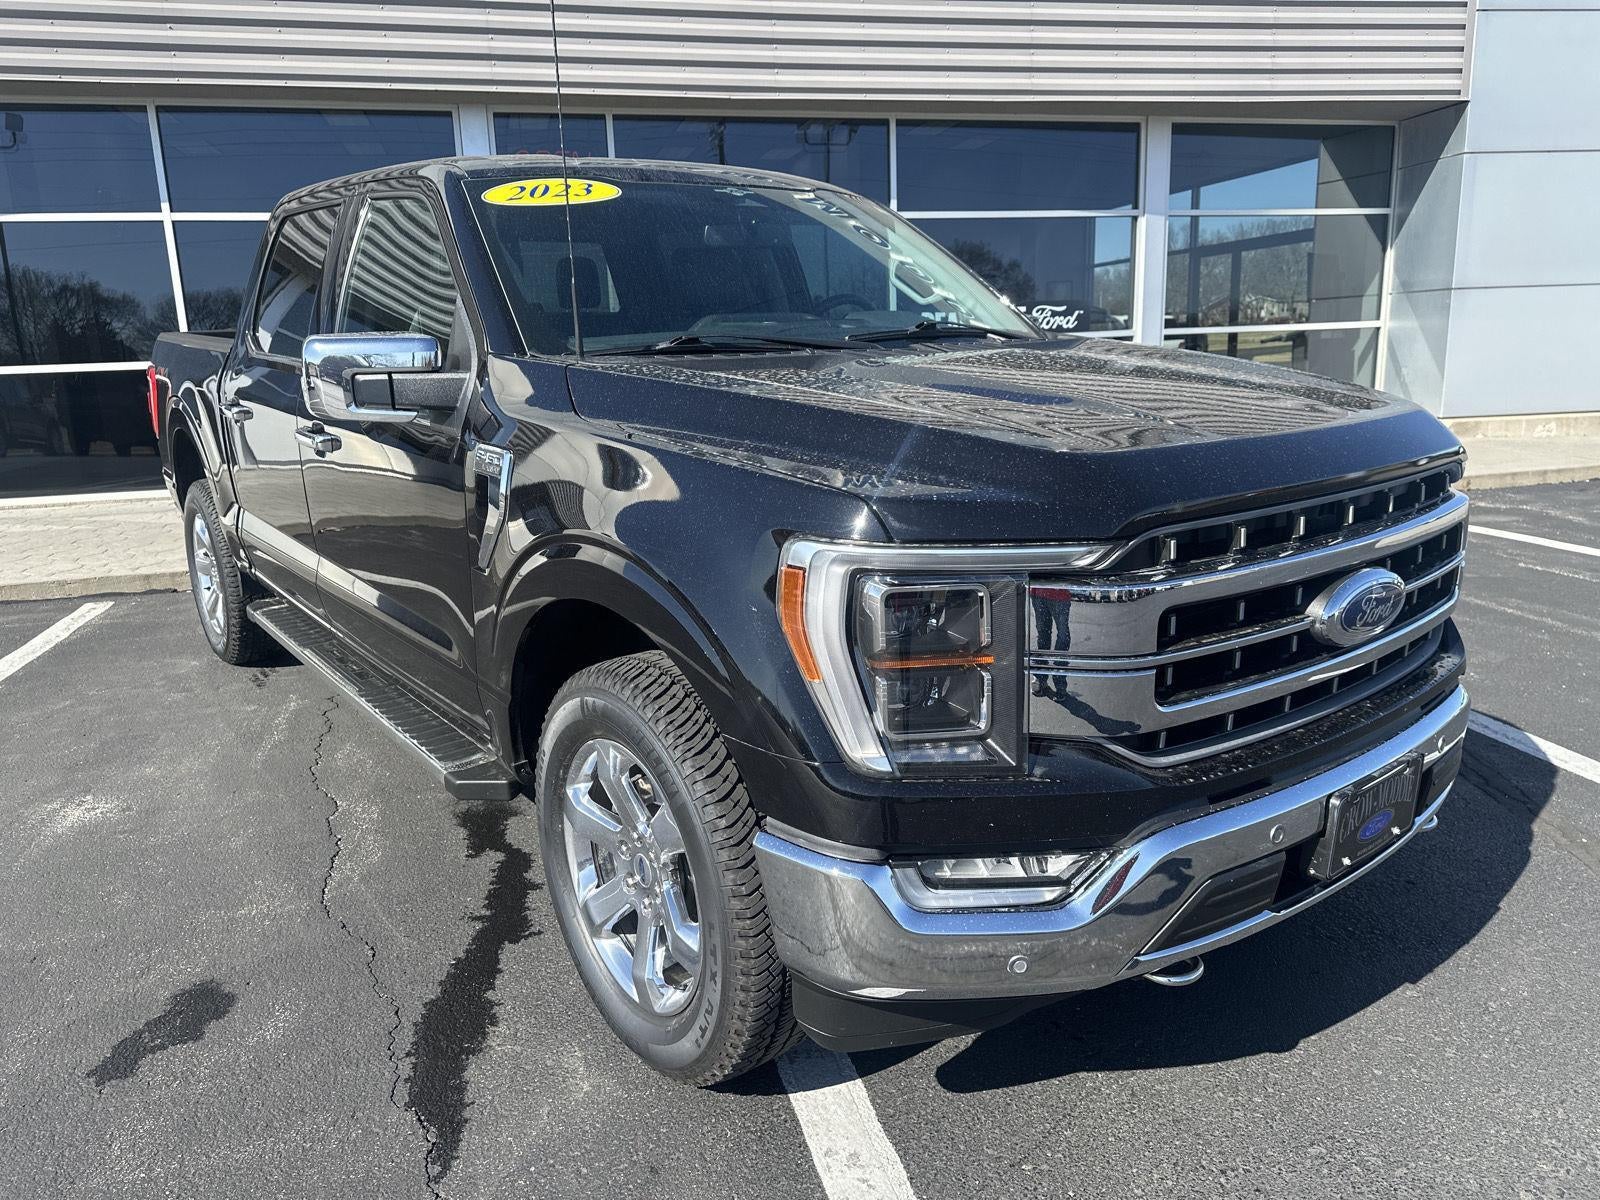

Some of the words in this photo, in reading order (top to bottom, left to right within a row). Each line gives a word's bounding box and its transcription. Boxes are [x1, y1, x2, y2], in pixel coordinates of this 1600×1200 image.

[506, 182, 593, 202] 2023
[1031, 304, 1079, 330] Ford
[1355, 591, 1396, 627] Ford
